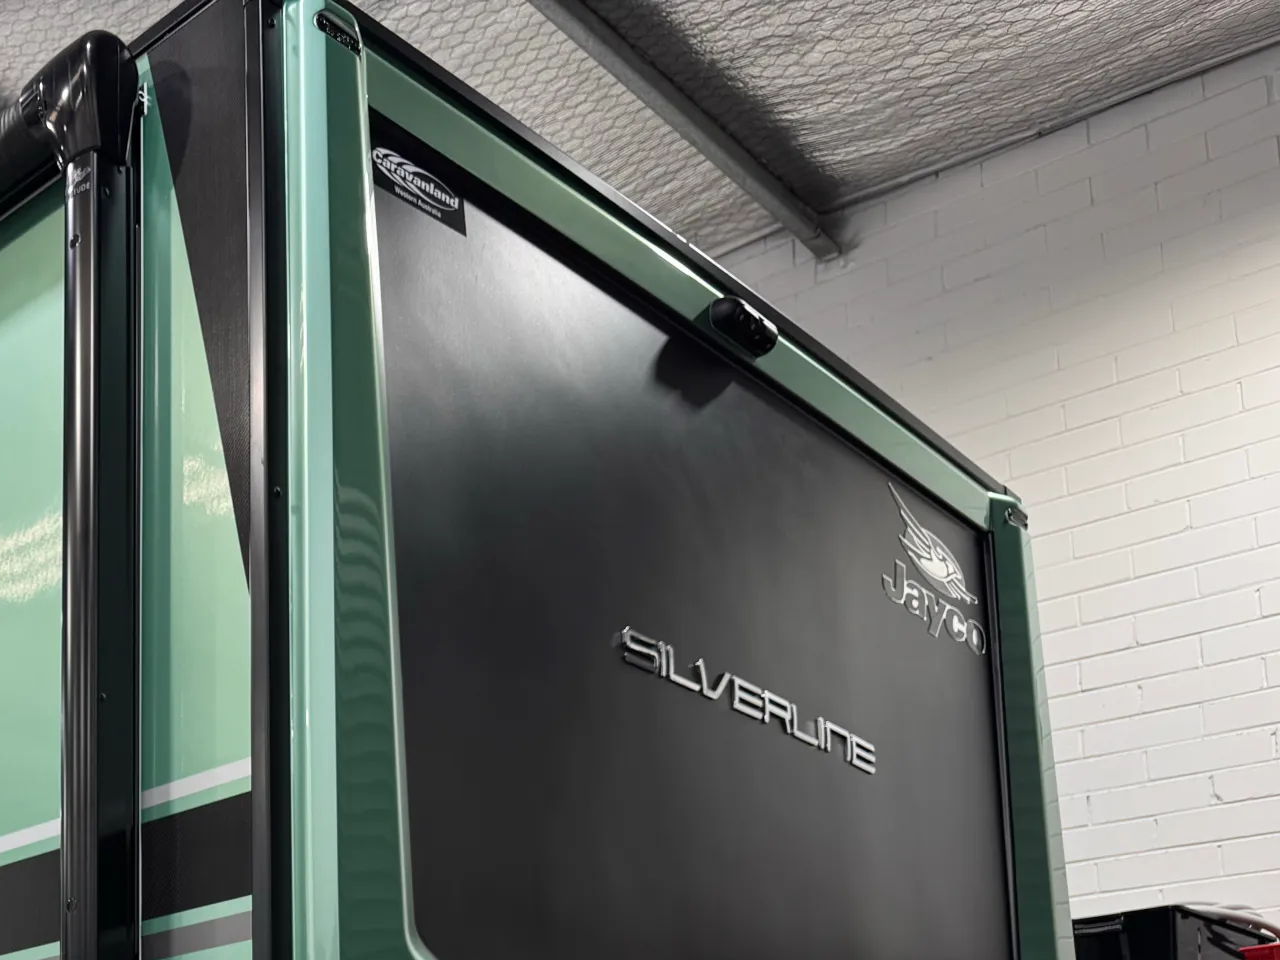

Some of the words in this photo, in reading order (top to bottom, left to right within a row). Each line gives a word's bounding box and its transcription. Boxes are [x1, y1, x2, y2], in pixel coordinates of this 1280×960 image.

[372, 149, 459, 209] Caravanland
[394, 185, 418, 204] Western
[417, 200, 442, 219] Australia
[882, 559, 986, 656] Jayco
[622, 625, 876, 774] SILVERLINE
